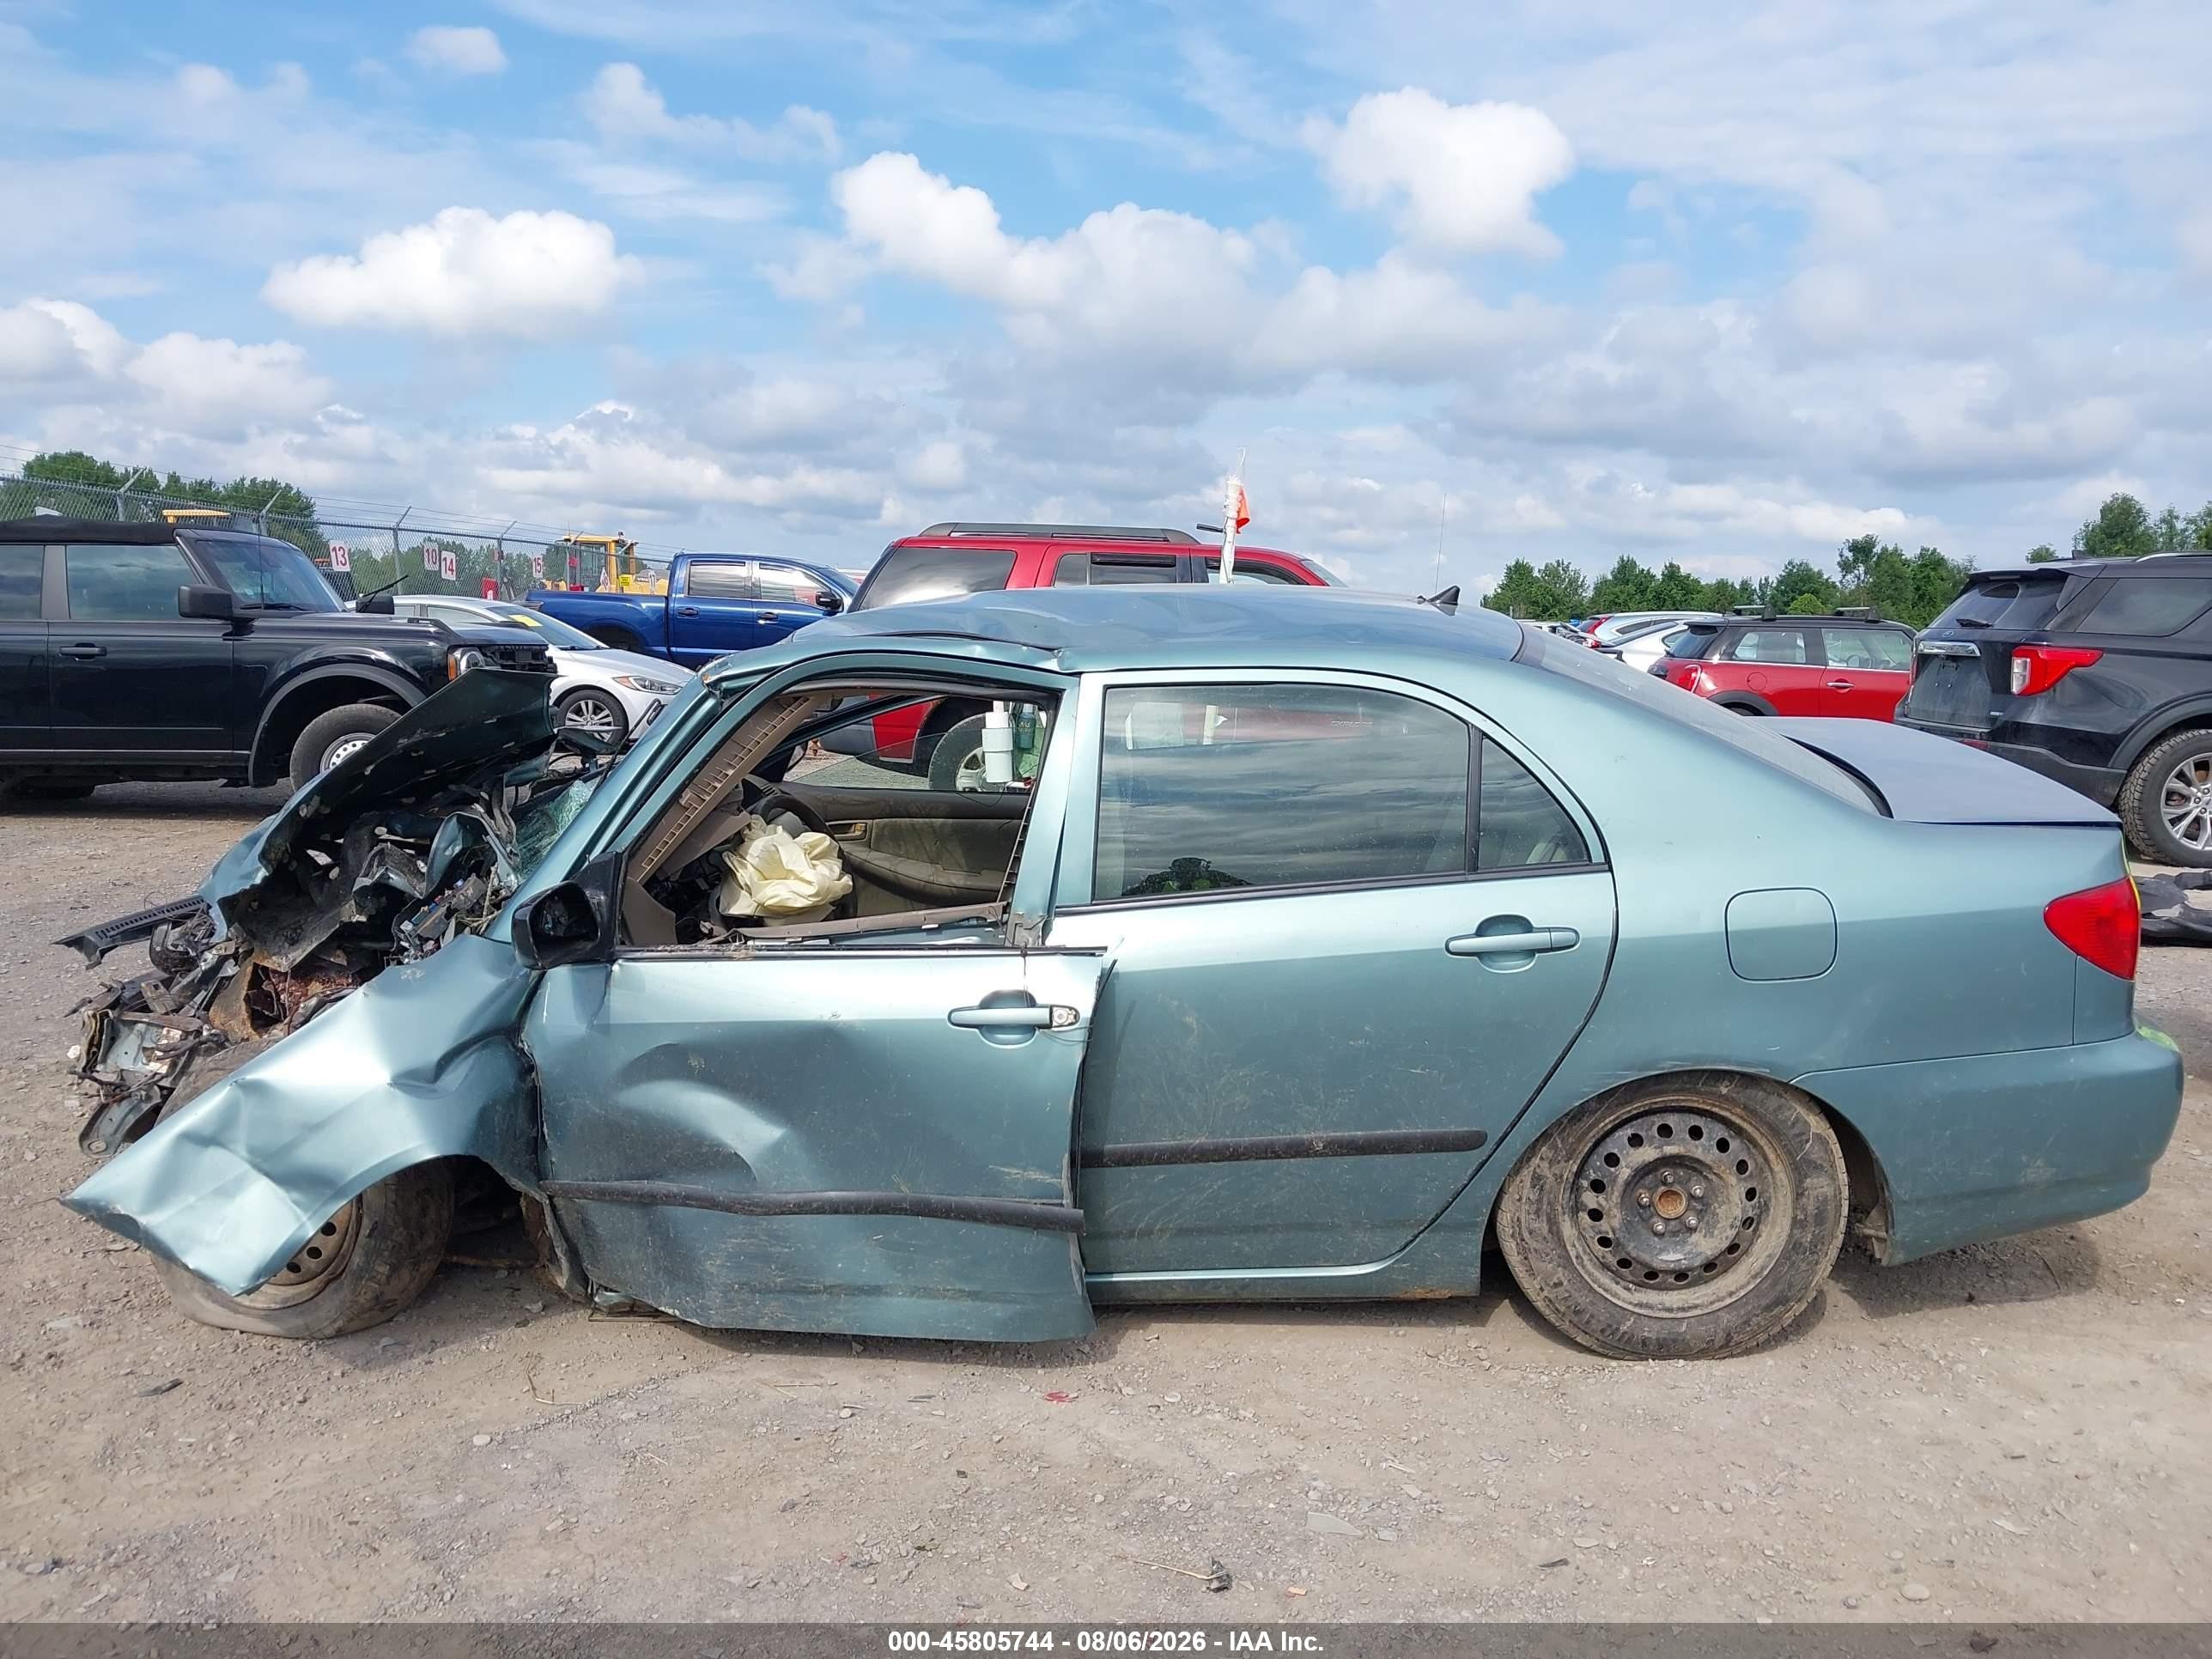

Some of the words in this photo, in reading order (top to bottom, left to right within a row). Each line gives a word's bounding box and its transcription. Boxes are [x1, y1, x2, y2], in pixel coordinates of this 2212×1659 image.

[331, 545, 348, 567] 13
[425, 548, 438, 566] 10
[534, 556, 542, 574] 15
[442, 556, 455, 575] 14
